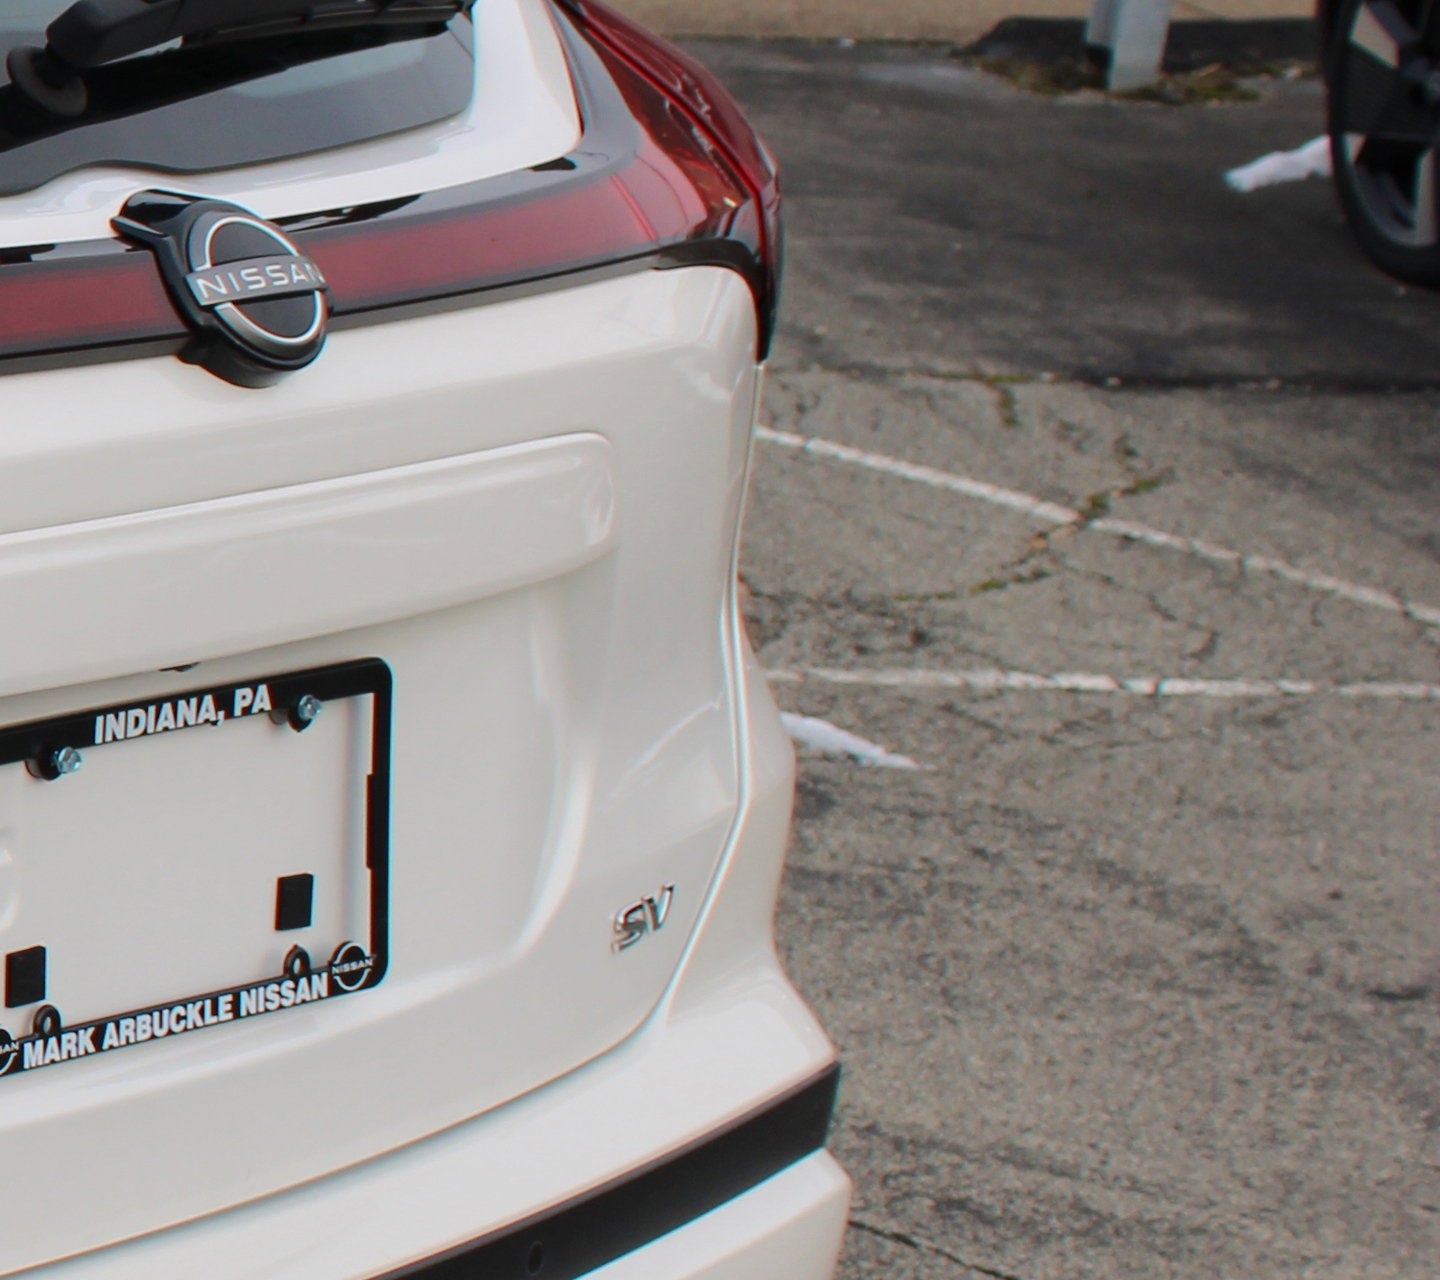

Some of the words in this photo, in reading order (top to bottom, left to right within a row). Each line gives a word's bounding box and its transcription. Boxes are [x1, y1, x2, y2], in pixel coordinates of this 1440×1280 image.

[195, 264, 324, 299] NISSAN
[92, 693, 225, 745] INDIANA,
[232, 682, 273, 717] PA
[610, 882, 675, 953] SV
[330, 954, 375, 978] NISSAN
[22, 1025, 96, 1070] MARK
[102, 993, 234, 1051] ARBUCKLE
[239, 971, 328, 1018] NISSAN
